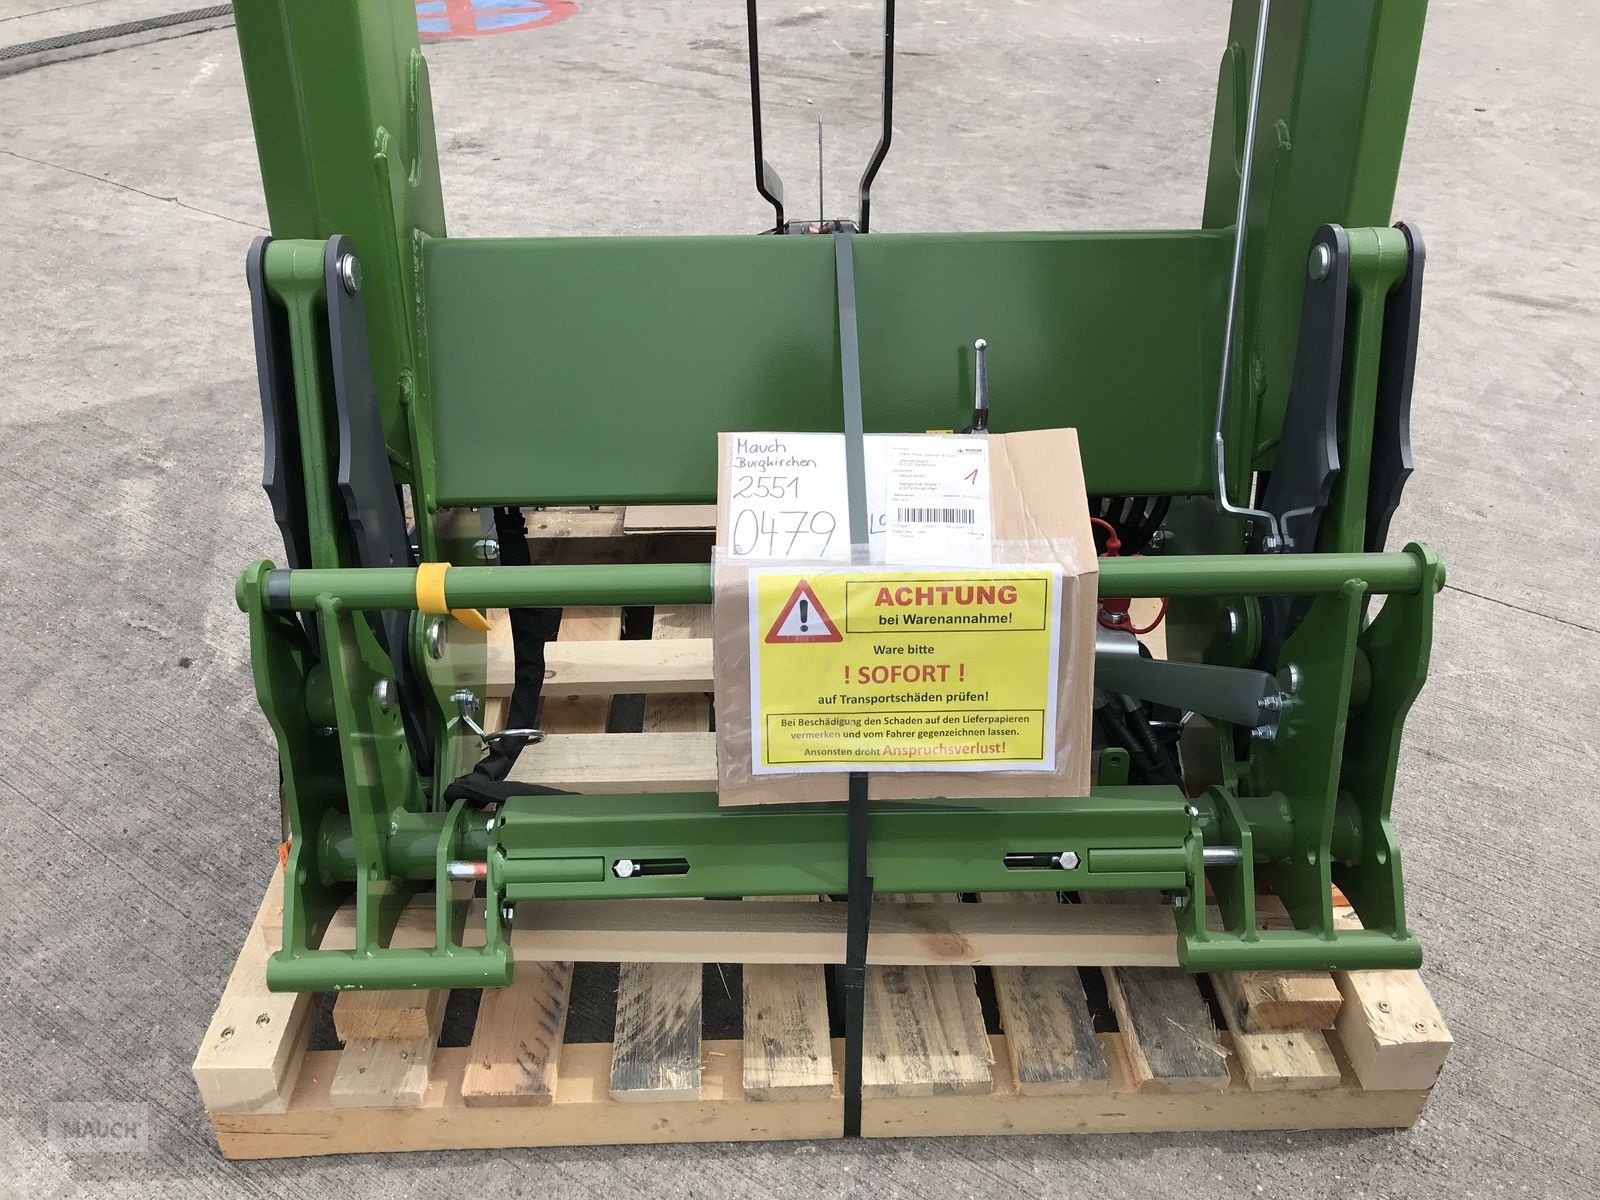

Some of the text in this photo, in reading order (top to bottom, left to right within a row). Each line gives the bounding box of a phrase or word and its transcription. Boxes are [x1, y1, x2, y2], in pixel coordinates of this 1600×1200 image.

[737, 438, 786, 454] Mauch
[733, 456, 816, 471] Burgkirchen
[733, 476, 799, 498] 2551
[733, 509, 836, 557] 0479
[875, 586, 1018, 606] ACHTUNG
[879, 613, 1013, 625] bei Warenannahme!
[874, 644, 935, 655] Ware bitte
[858, 665, 951, 685] SOFORT
[818, 692, 989, 706] auf Transportschäden prüfen!
[781, 715, 1029, 728] Bei Beschädigung den Schaden auf den Lieferpapieren
[791, 730, 840, 739] vermerken
[843, 729, 861, 738] und
[886, 729, 915, 738] Fahrer
[917, 728, 985, 740] gegenzeichnen
[988, 727, 1019, 736] lassen.
[804, 743, 1006, 759] Ansonsten droht Anspruchsverlust!
